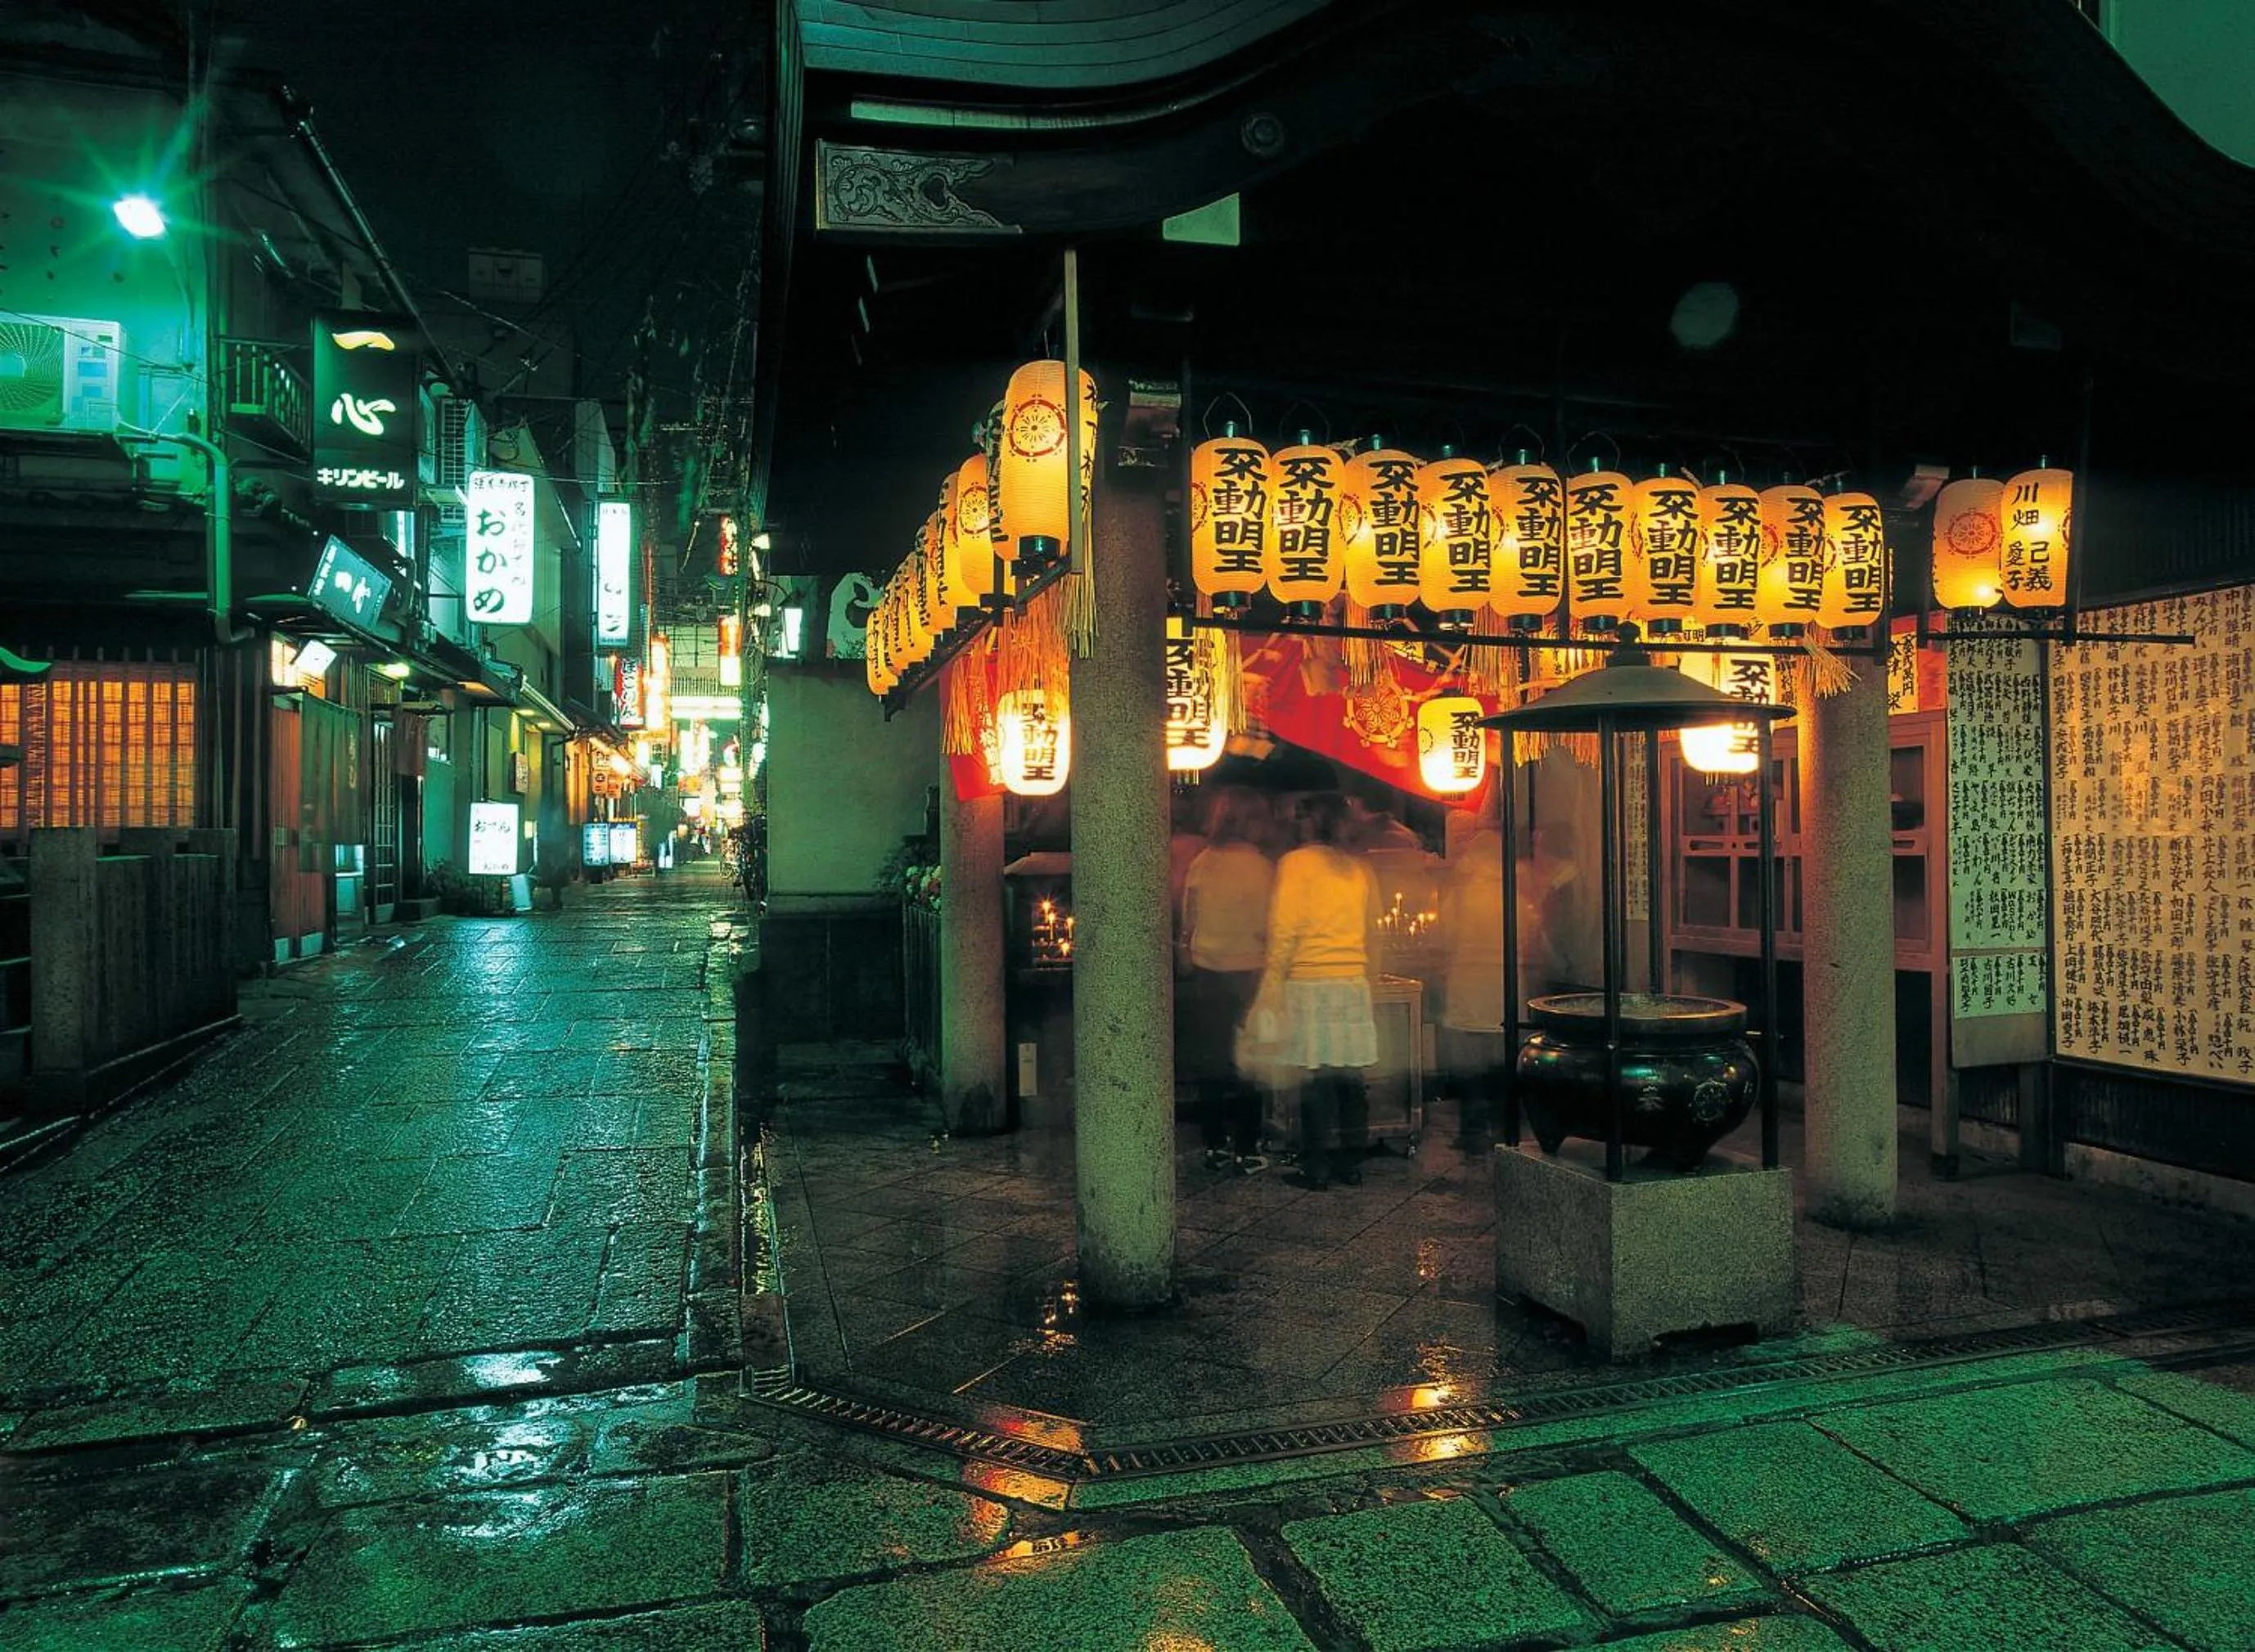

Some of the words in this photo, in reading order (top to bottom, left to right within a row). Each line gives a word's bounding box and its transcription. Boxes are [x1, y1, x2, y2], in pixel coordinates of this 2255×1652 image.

[317, 468, 405, 489] キリンビール
[2010, 482, 2040, 531] 川畑
[473, 508, 508, 614] おかめ
